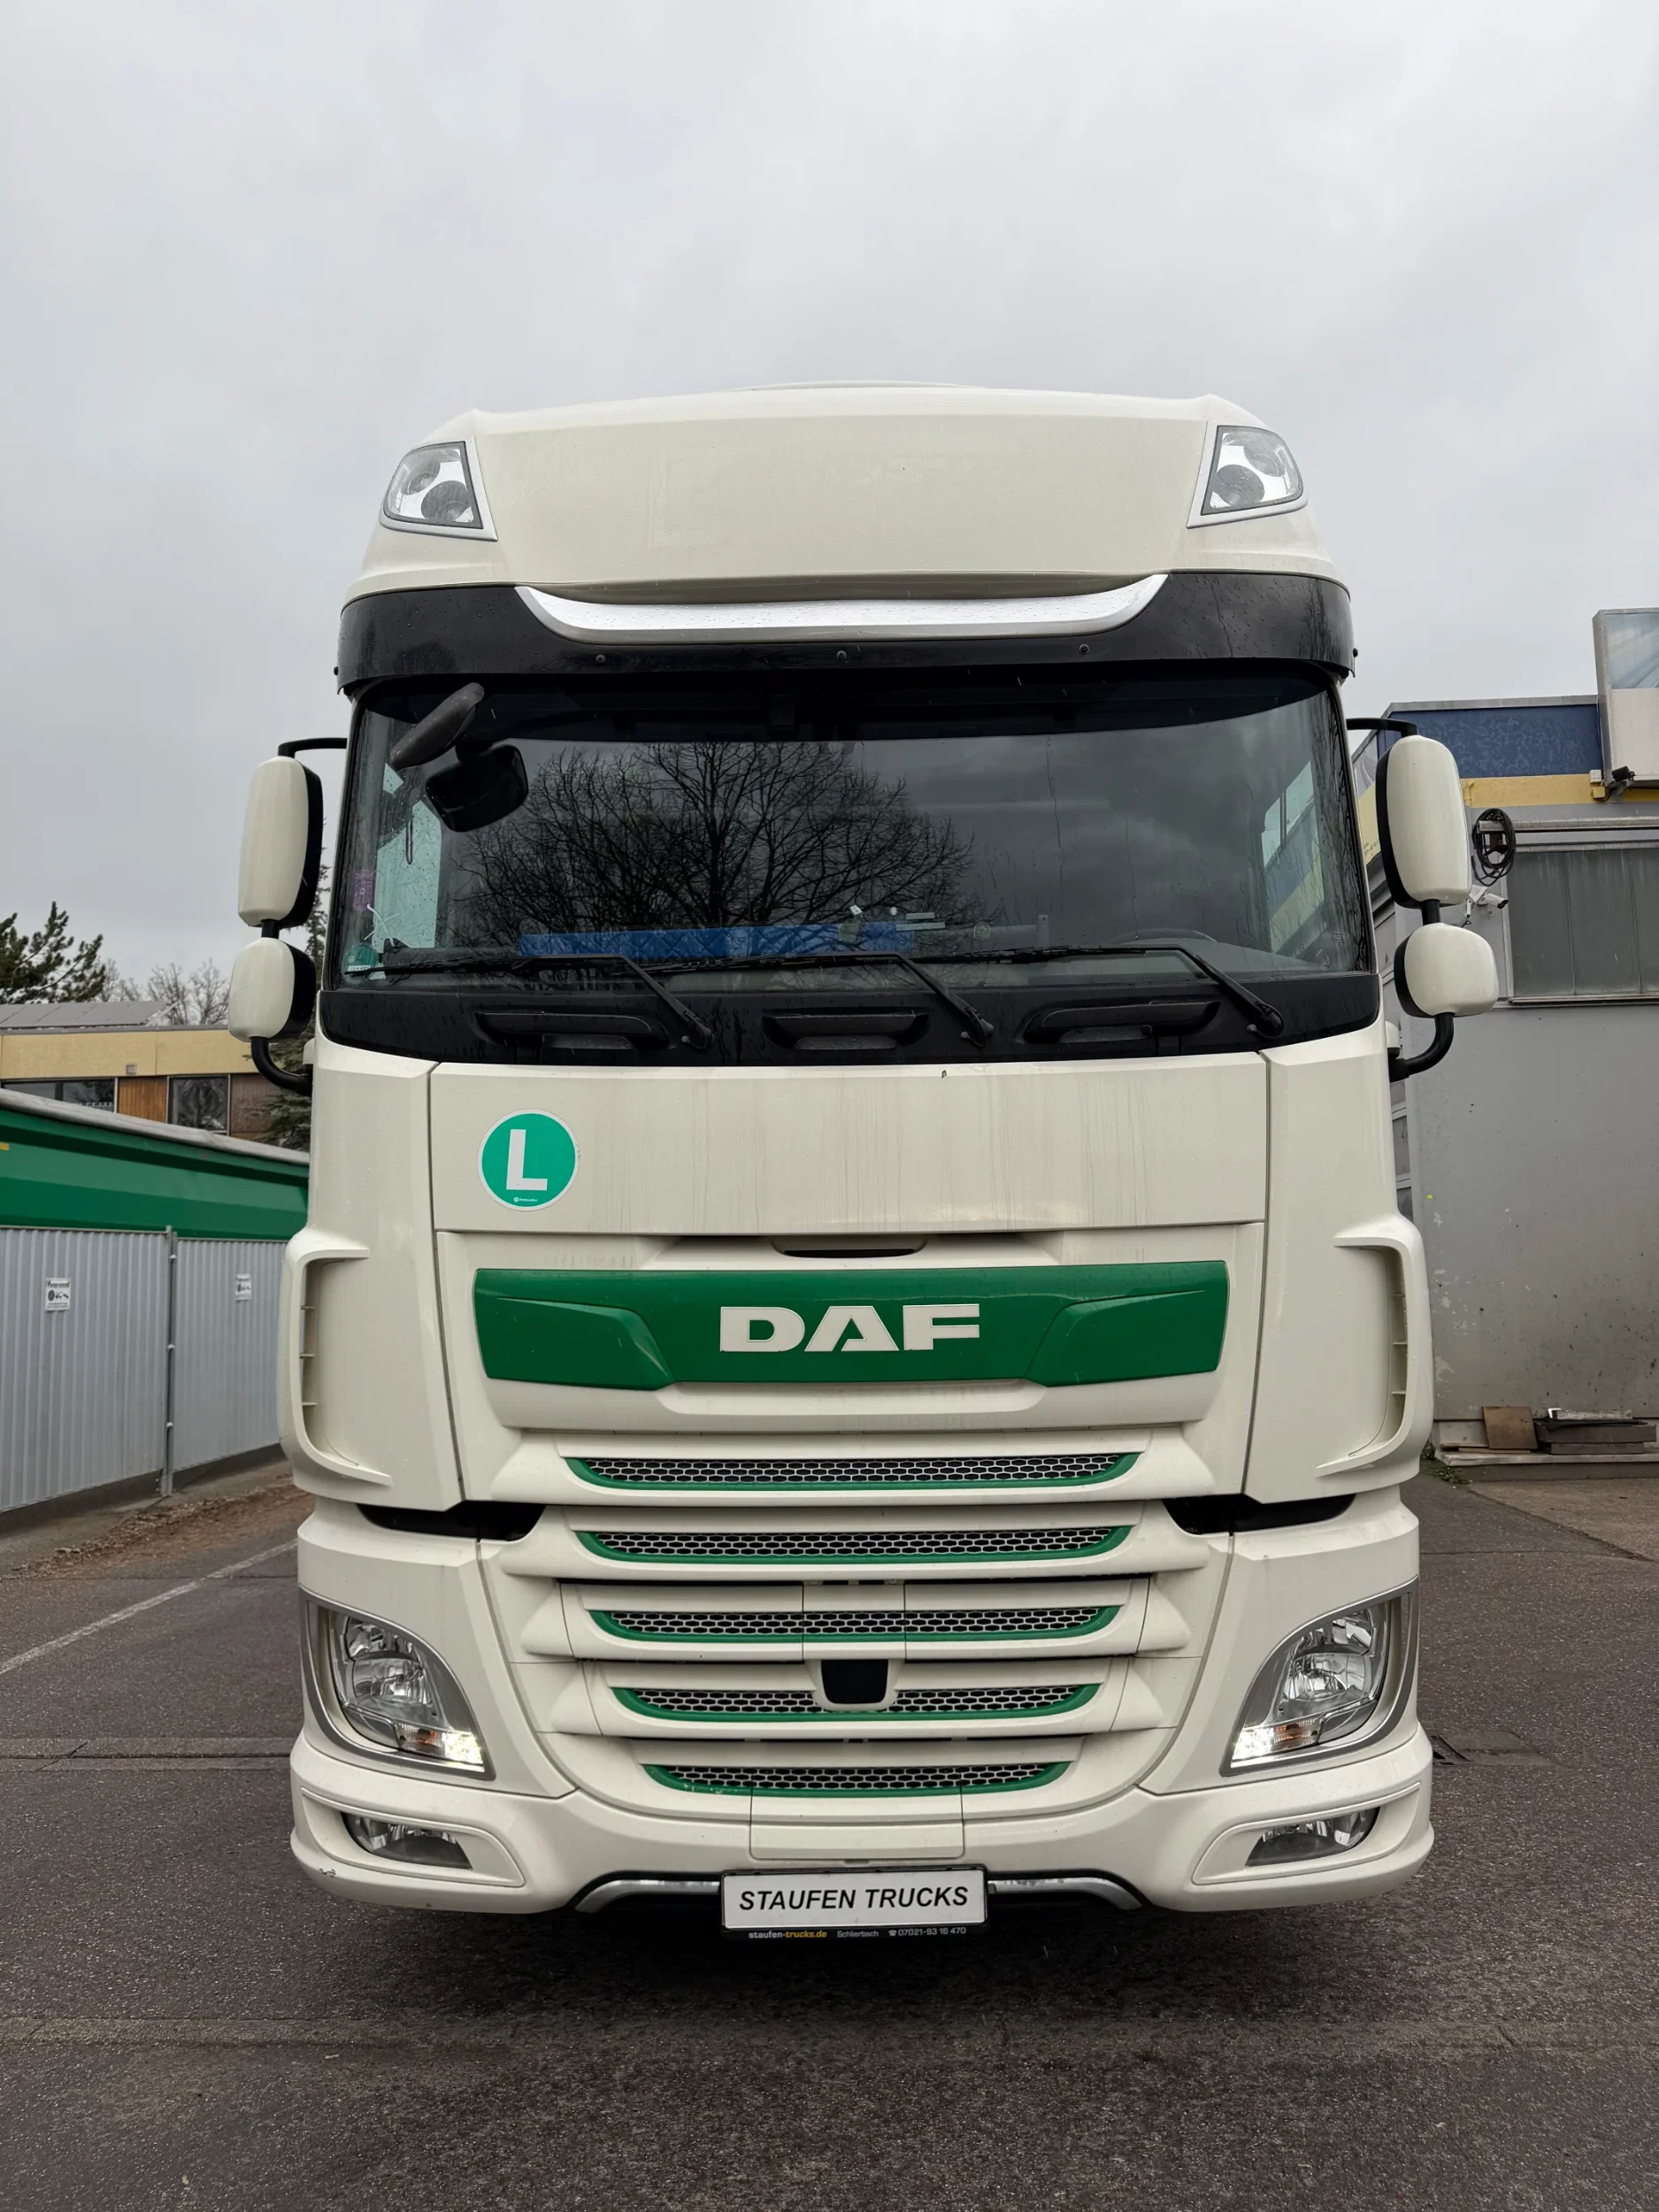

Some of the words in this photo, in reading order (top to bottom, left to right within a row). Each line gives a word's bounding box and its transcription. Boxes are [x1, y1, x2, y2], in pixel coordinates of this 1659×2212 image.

[505, 1128, 548, 1191] L
[719, 1303, 980, 1352] DAF
[739, 1889, 856, 1910] STAUFEN
[864, 1886, 968, 1909] TRUCKS
[749, 1930, 827, 1939] staufen-trucks.de
